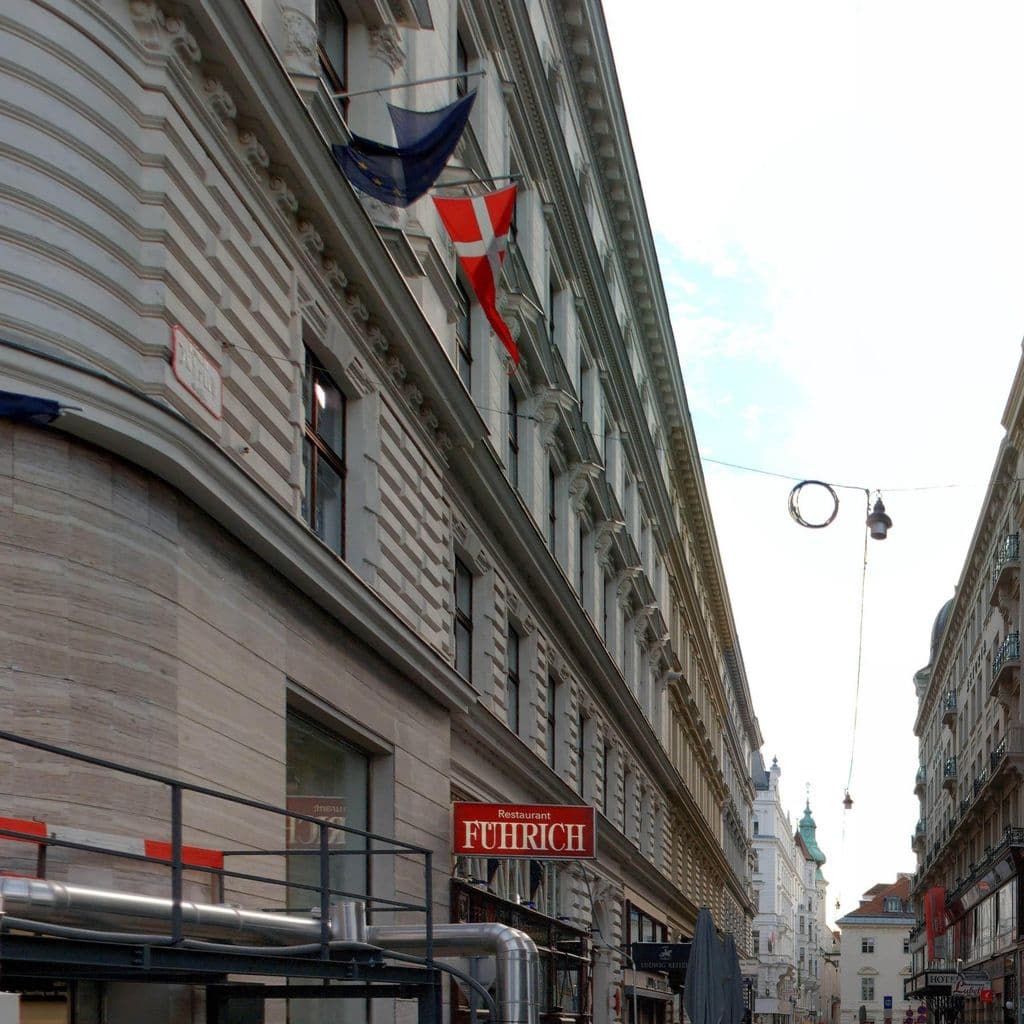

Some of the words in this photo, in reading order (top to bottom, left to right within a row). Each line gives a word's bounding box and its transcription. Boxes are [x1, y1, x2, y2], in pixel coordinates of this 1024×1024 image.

[498, 809, 551, 820] Restaurant
[462, 820, 587, 852] FÜHRICH
[930, 975, 955, 984] HOTE
